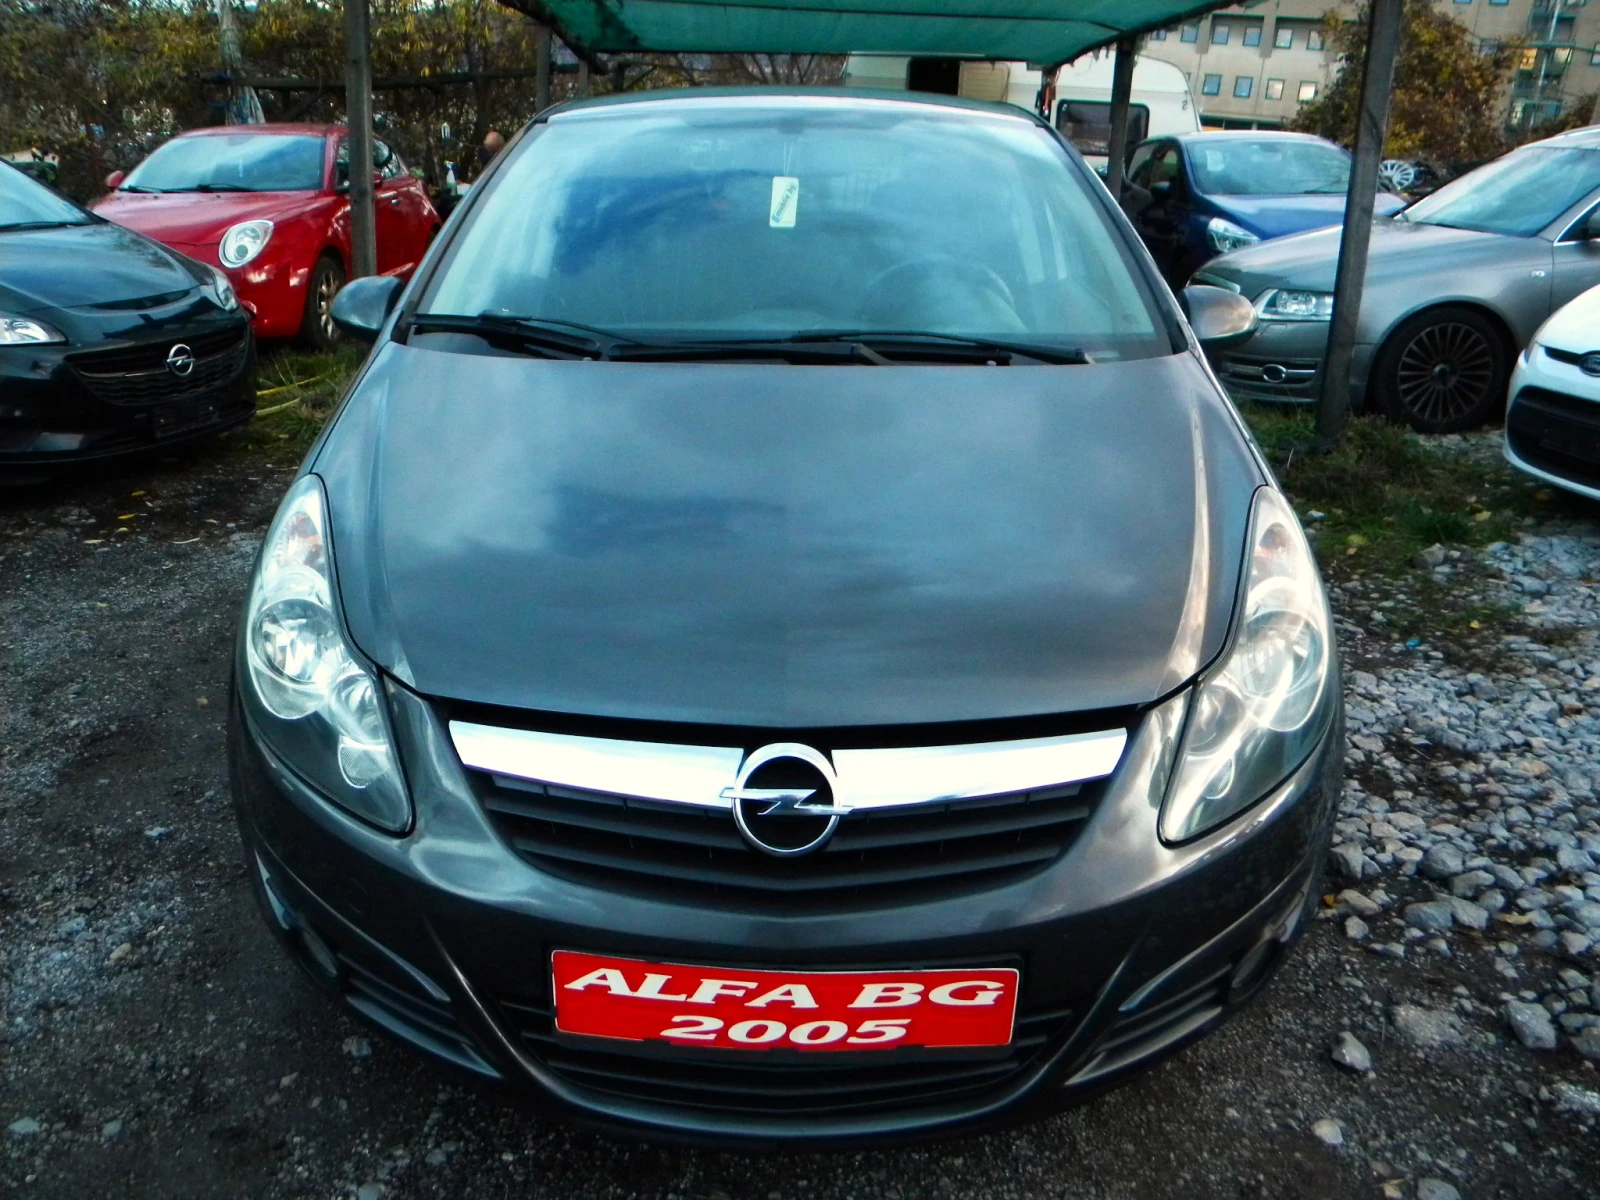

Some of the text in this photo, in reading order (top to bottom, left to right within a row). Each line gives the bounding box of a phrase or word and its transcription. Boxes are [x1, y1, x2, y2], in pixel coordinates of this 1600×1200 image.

[564, 967, 1005, 1009] ALFA BG
[659, 1015, 912, 1045] 2005
